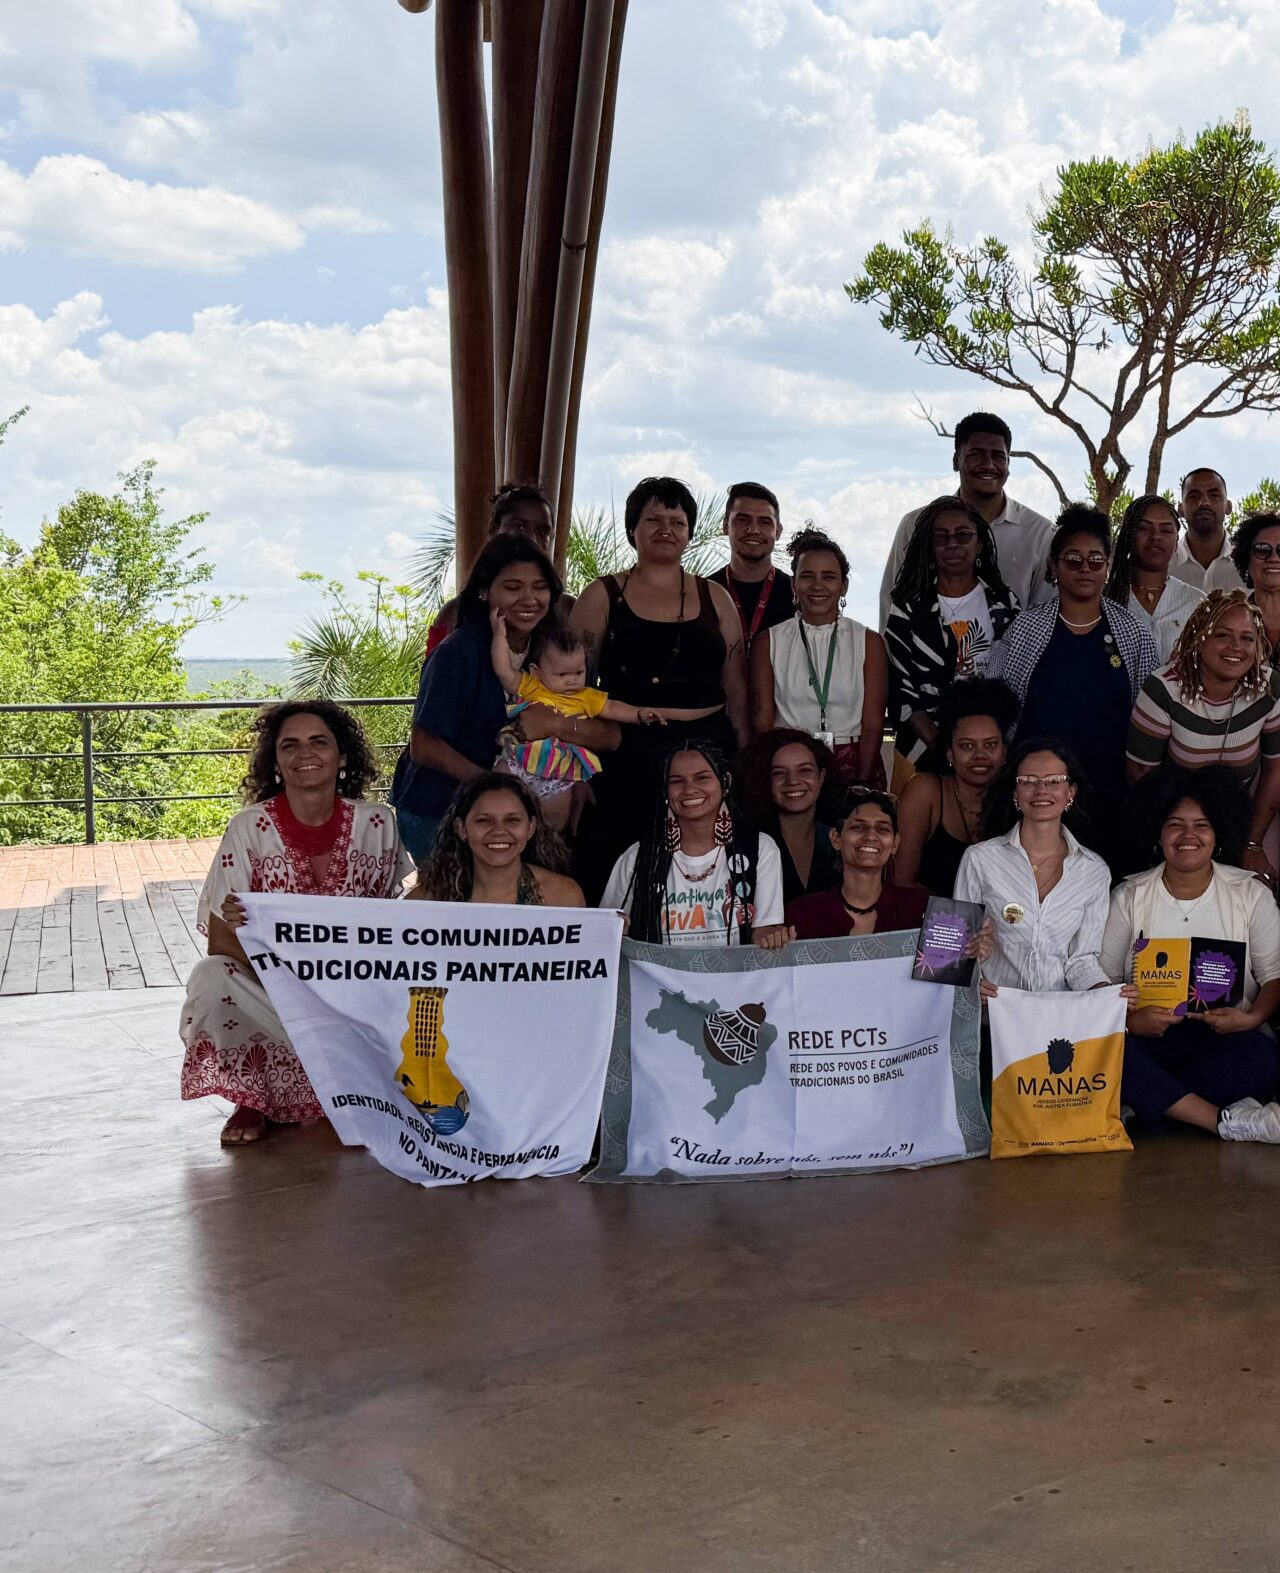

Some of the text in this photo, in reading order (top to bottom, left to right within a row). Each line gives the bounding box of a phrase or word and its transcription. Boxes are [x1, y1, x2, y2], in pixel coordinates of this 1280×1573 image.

[663, 888, 724, 910] aatinga
[275, 922, 582, 946] REDE DE COMUNIDADE
[446, 958, 608, 982] PANTANEIRA
[1140, 970, 1182, 980] MANAS
[788, 1028, 887, 1049] REDE PCTs
[790, 1043, 939, 1073] REDE DOS POVOS E COMUNIDADES
[789, 1068, 904, 1087] TRADICIONAIS DO BRASIL
[1017, 1073, 1107, 1096] MANAS
[398, 1131, 416, 1155] NO
[735, 1151, 784, 1166] sobre
[827, 1152, 862, 1161] sem
